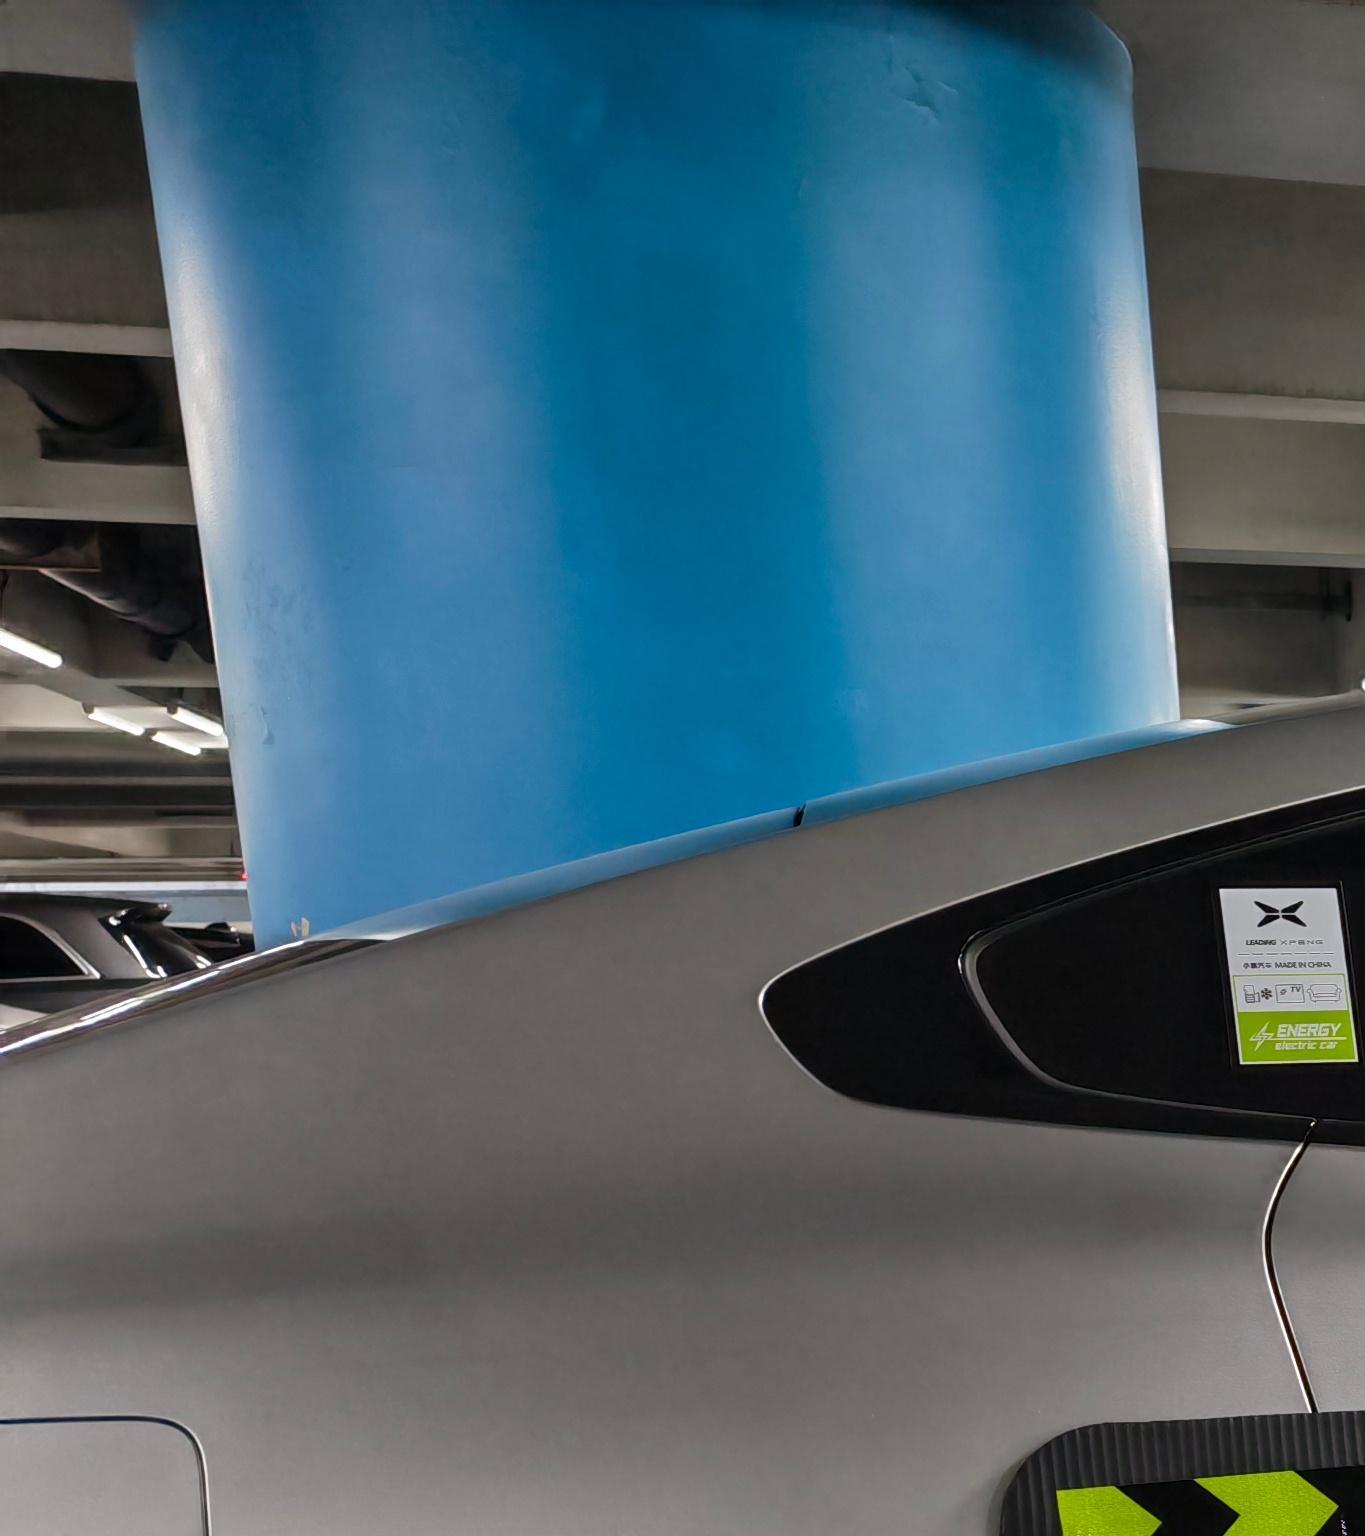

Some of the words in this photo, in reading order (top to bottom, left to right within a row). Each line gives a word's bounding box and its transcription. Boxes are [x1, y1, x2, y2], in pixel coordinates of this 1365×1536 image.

[1274, 961, 1298, 969] MADE
[1307, 960, 1332, 968] CHINA
[1276, 1022, 1342, 1038] ENERGY
[1274, 1040, 1317, 1051] electric
[1319, 1040, 1339, 1050] car
